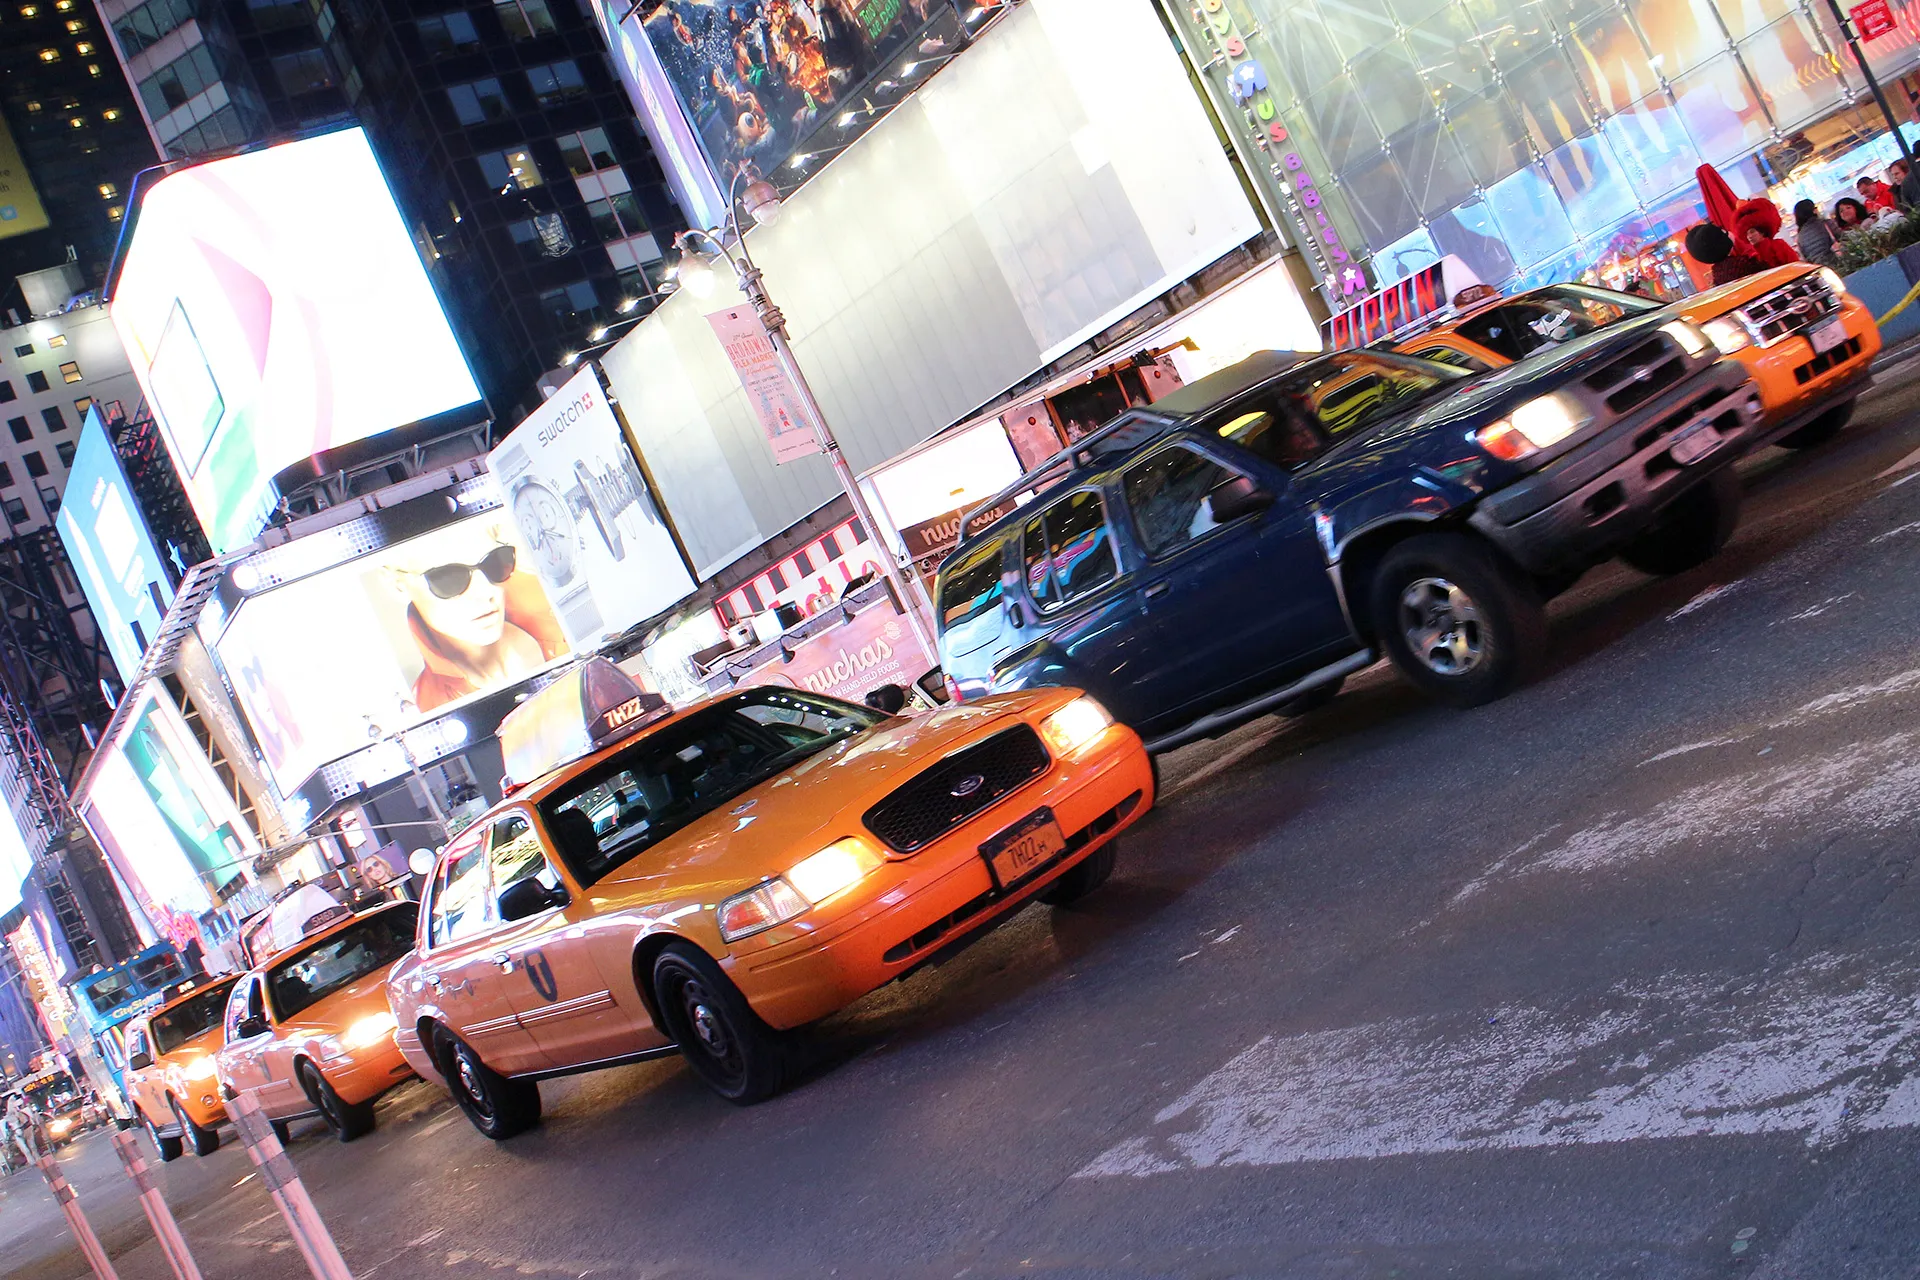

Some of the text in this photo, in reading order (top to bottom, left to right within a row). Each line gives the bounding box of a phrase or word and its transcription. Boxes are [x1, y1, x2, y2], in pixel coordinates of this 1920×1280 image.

[1257, 98, 1289, 143] US
[1284, 152, 1349, 264] BABIES
[1332, 267, 1438, 351] PIPPIN
[726, 335, 773, 361] BROADWAY
[734, 351, 776, 369] FLEA MARKET
[537, 398, 586, 448] swatch
[802, 637, 893, 692] nuchas
[841, 670, 878, 694] HAND-HELD
[878, 660, 900, 675] FOODS
[602, 696, 645, 729] 7H22
